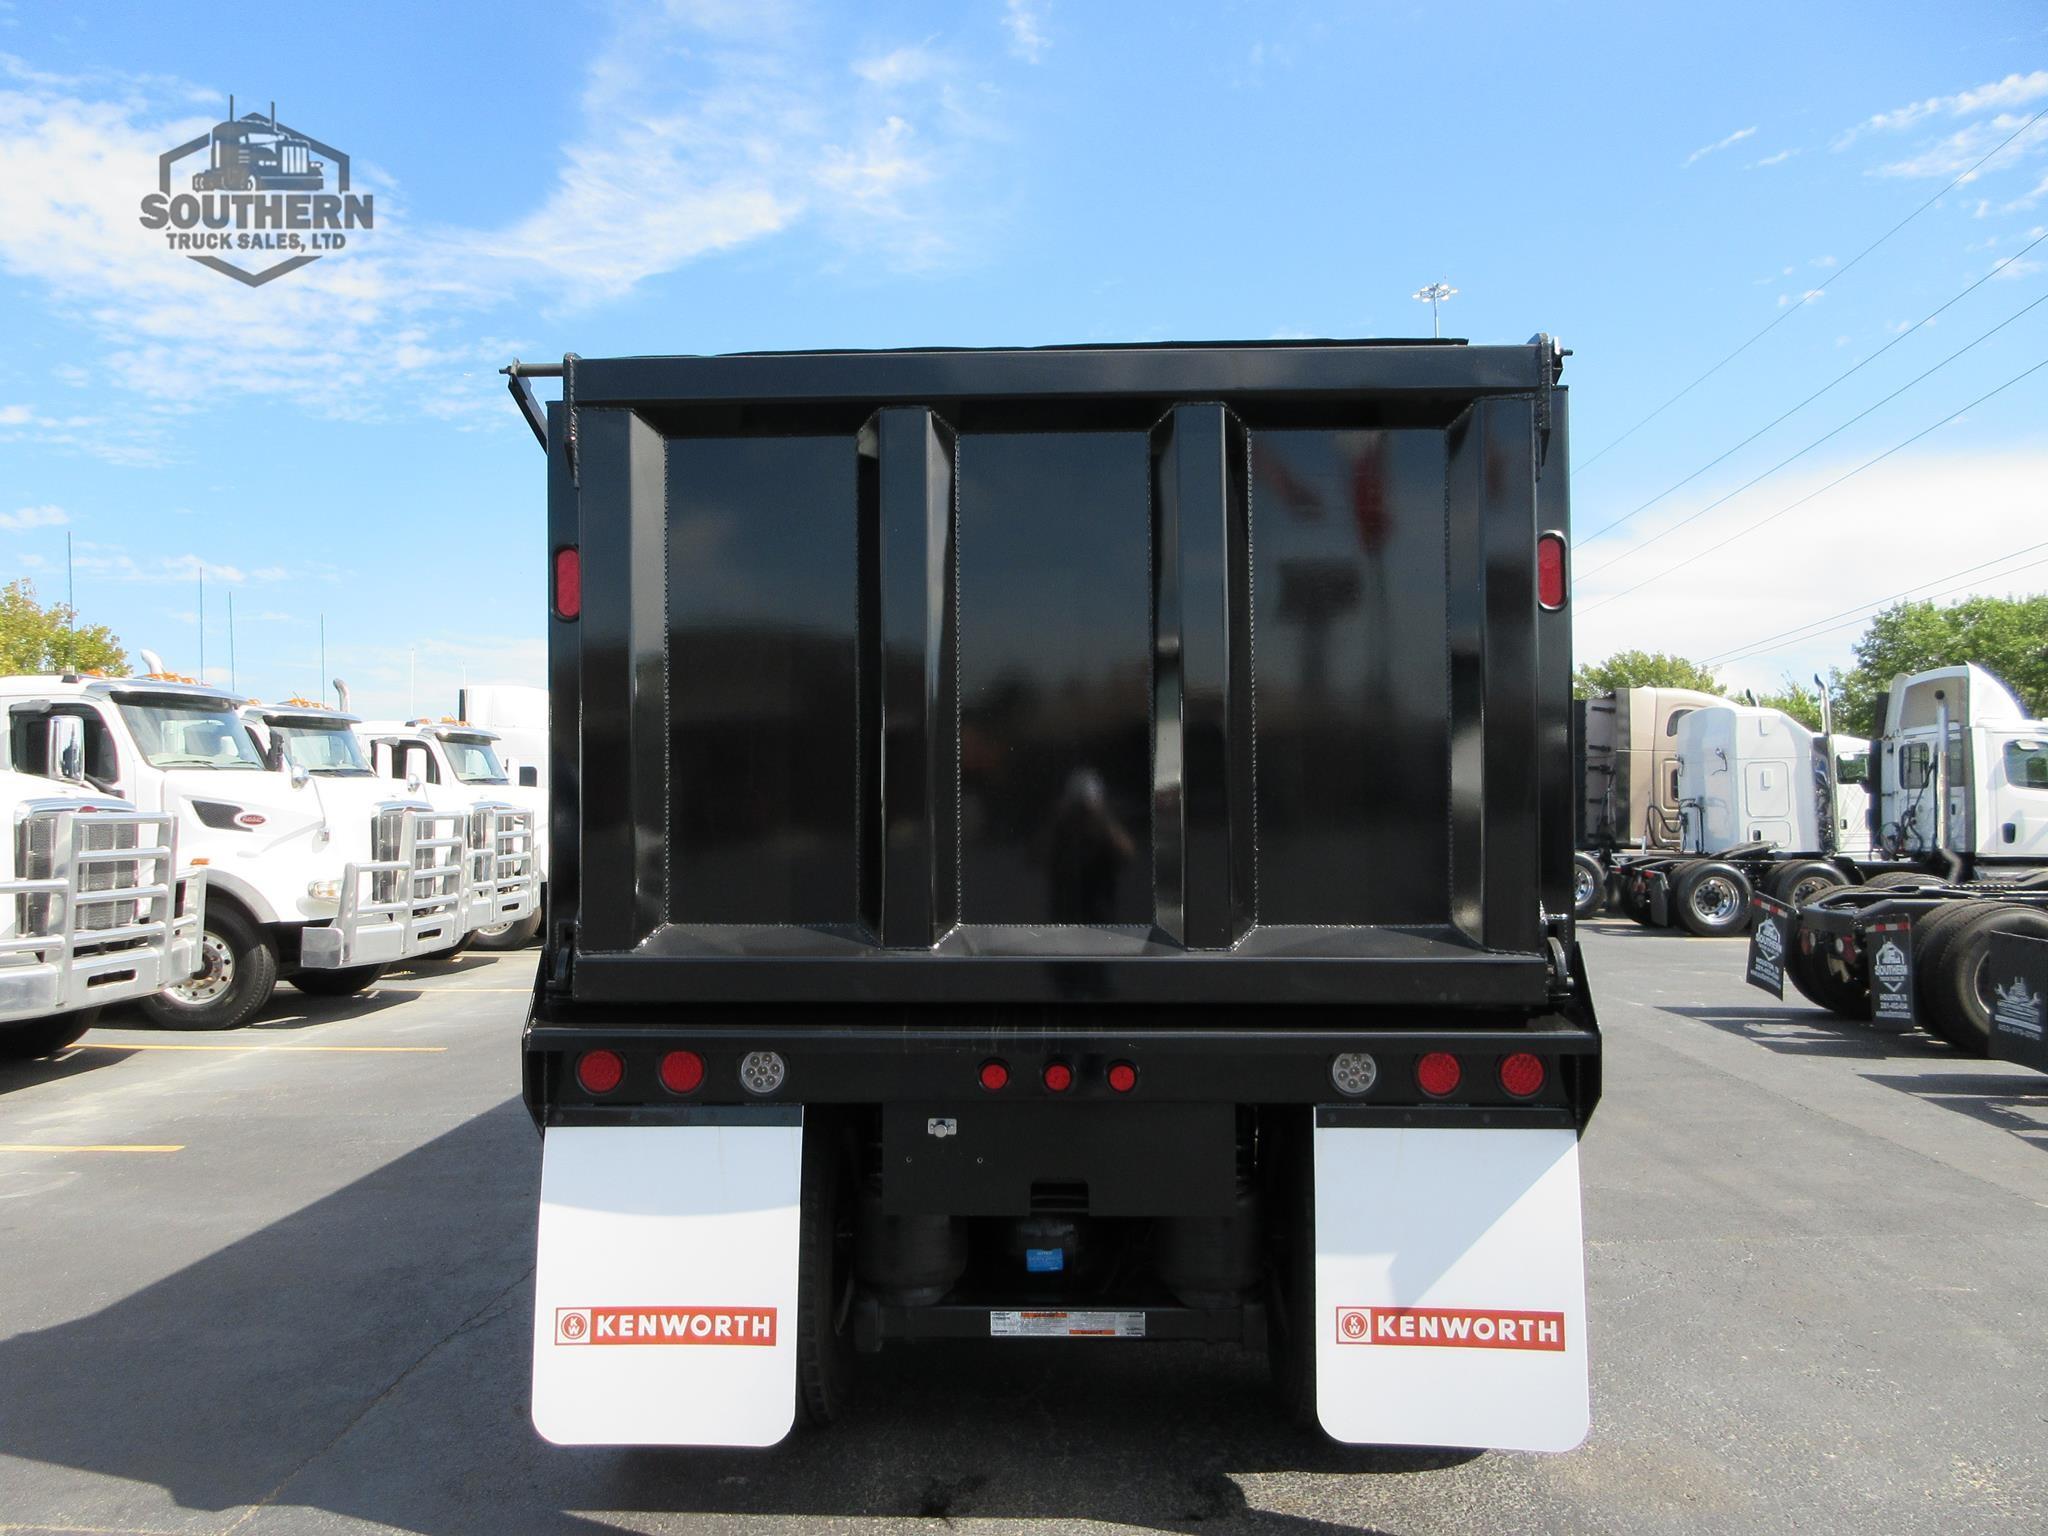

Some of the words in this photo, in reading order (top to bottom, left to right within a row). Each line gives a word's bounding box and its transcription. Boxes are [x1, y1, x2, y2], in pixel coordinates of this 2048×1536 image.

[1755, 932, 1782, 954] SOUTHERN
[1874, 965, 1908, 976] SOUTHERN
[597, 1314, 771, 1338] KENWORTH
[1377, 1315, 1558, 1343] KENWORTH
